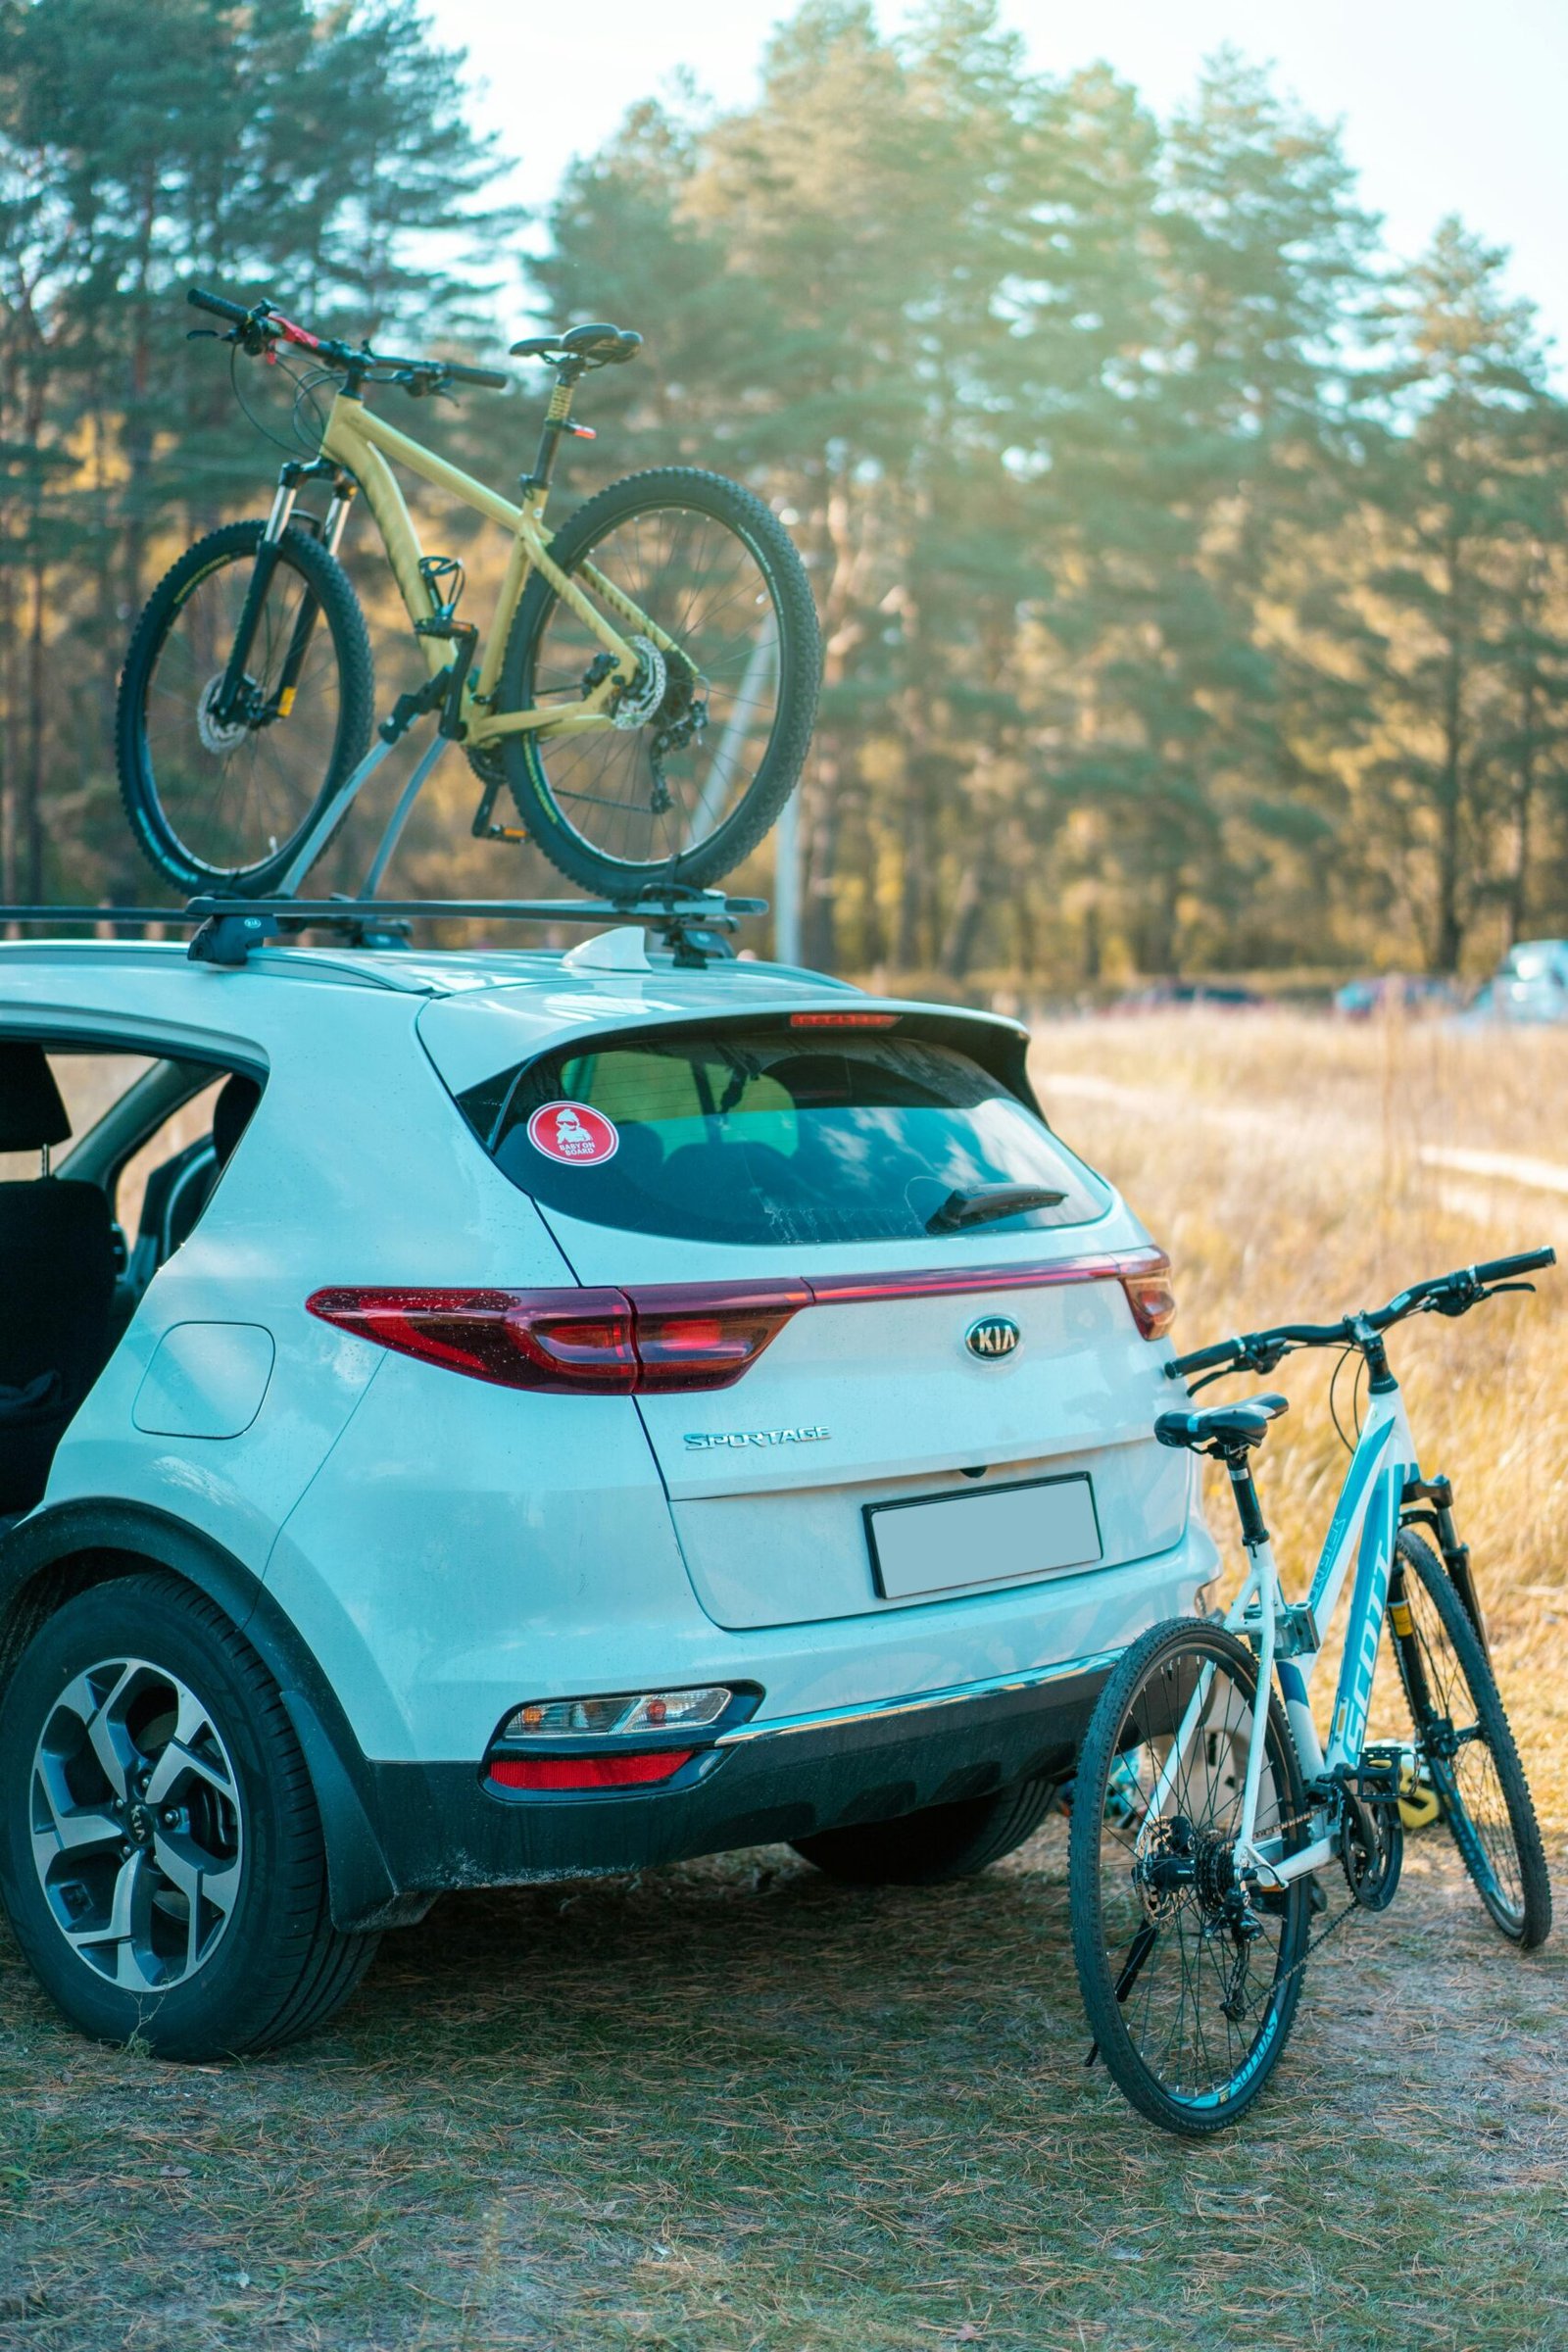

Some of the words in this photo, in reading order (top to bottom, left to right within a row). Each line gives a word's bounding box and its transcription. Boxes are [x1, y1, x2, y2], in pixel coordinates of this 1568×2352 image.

[559, 1142, 580, 1152] BABY
[977, 1325, 1015, 1351] KIA
[683, 1426, 831, 1450] SPORTAGE
[1345, 1540, 1390, 1750] SCOTT
[131, 1804, 146, 1841] KIA
